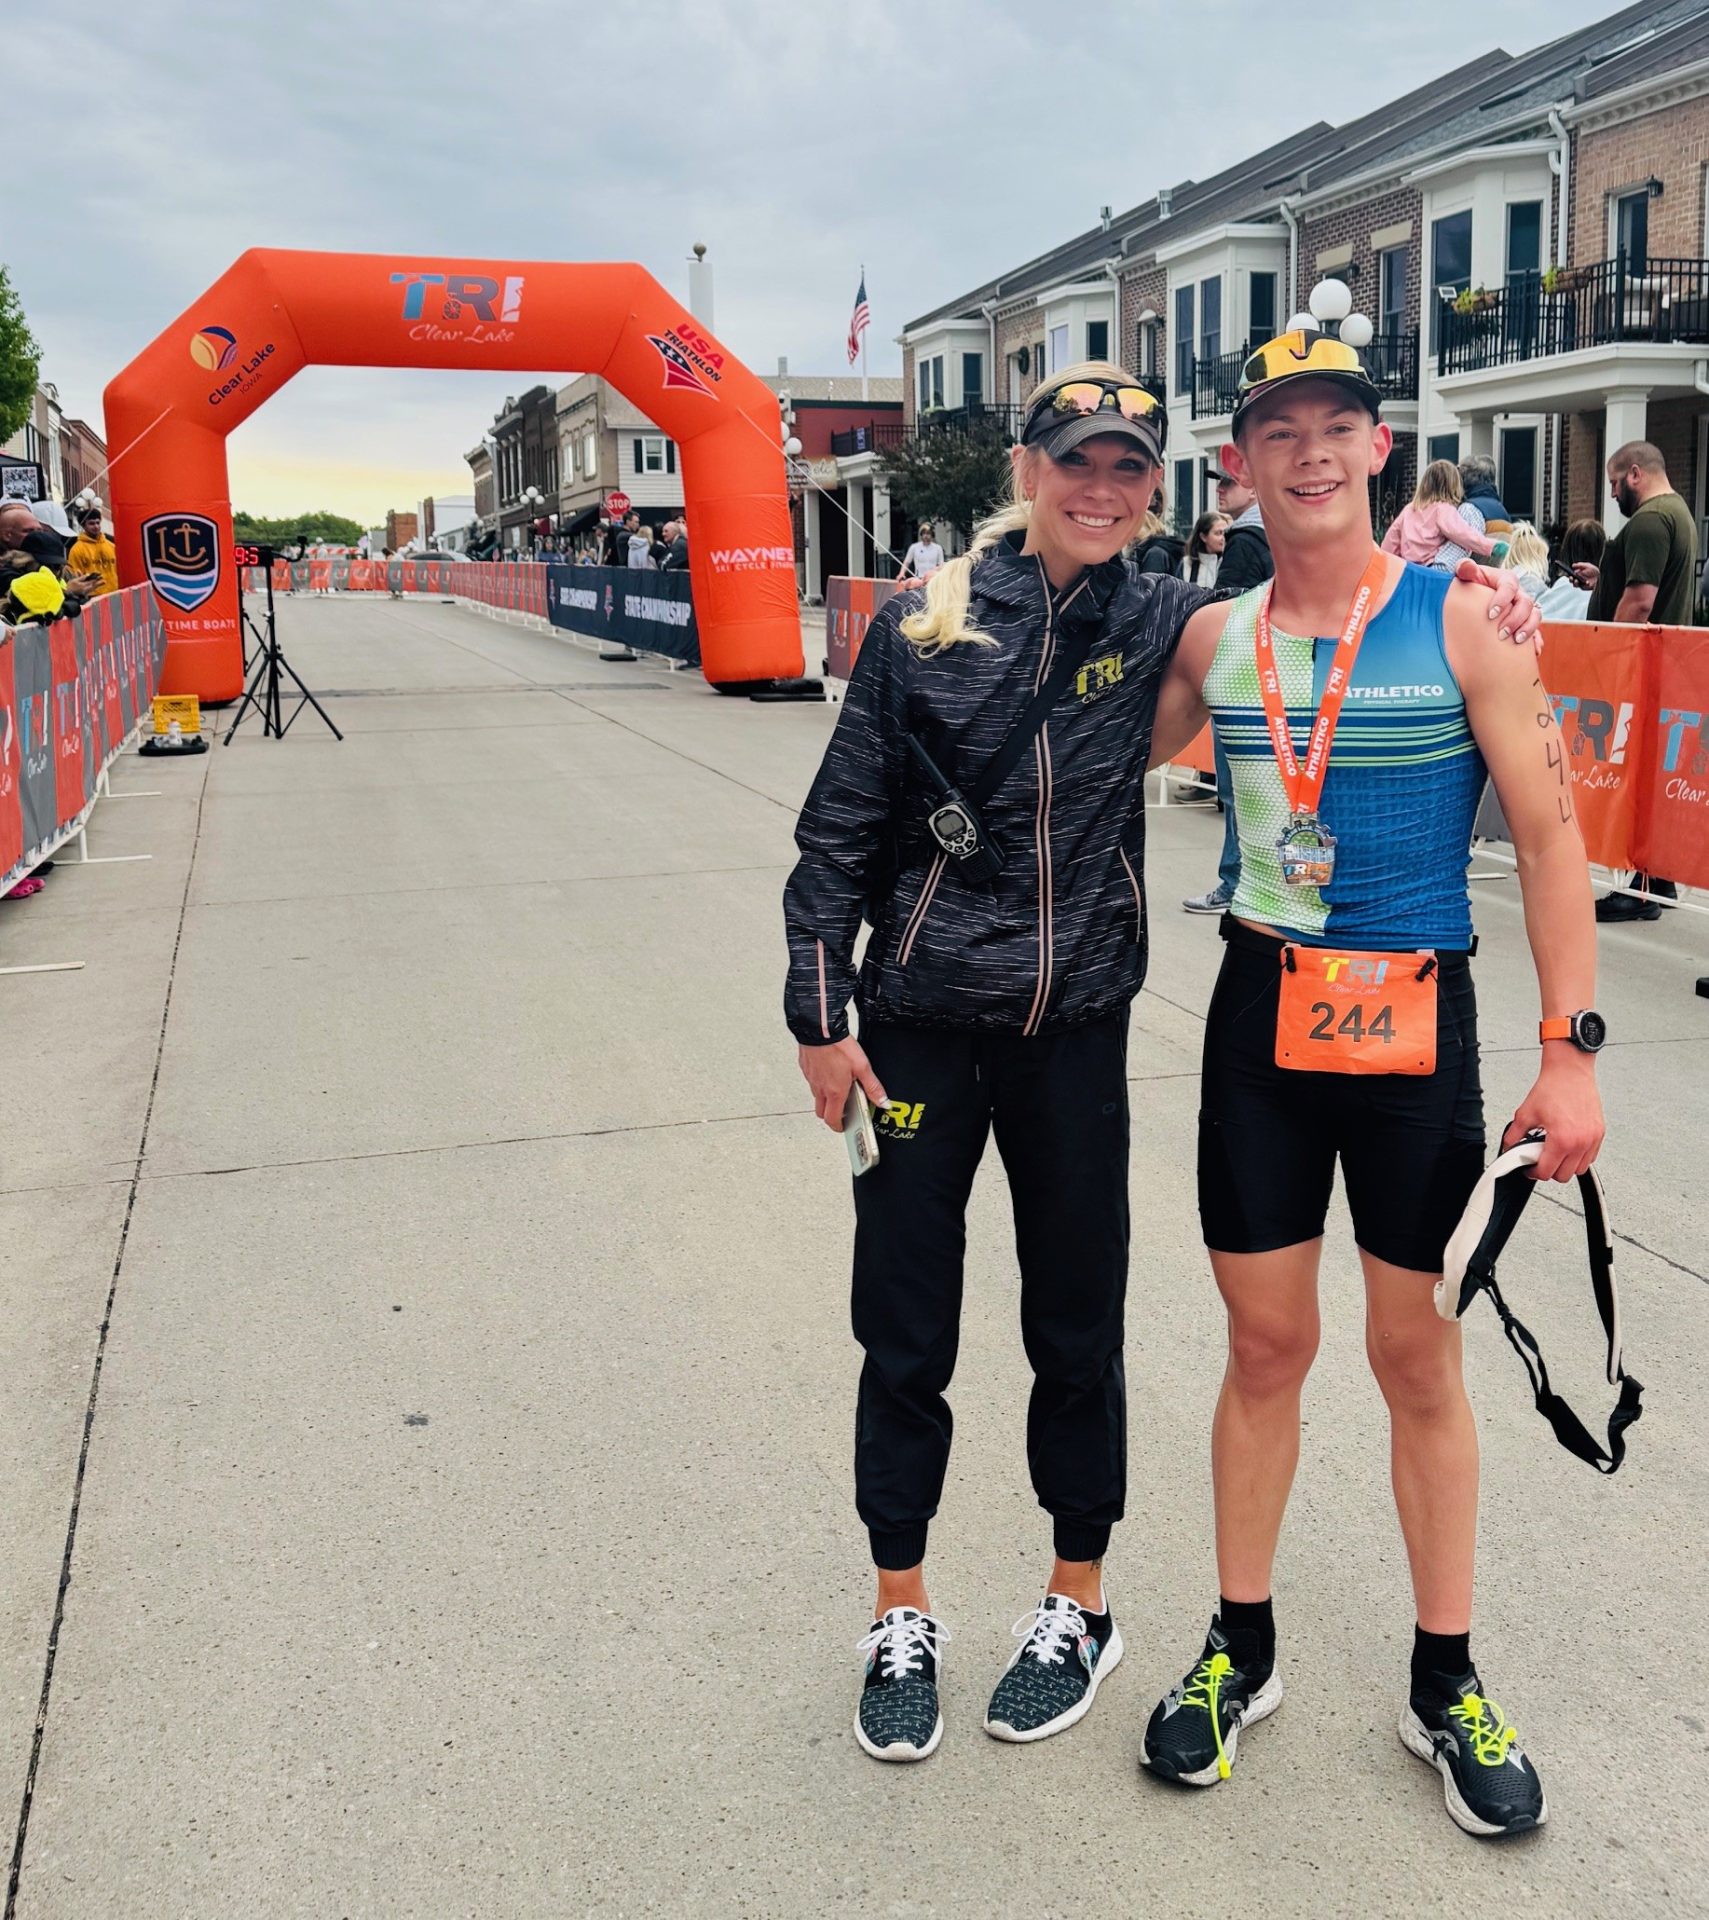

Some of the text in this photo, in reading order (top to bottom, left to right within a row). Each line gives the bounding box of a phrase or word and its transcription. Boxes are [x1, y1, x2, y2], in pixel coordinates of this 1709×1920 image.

[389, 272, 525, 322] TRI
[408, 323, 515, 344] Clear Lake
[676, 323, 724, 370] USA
[664, 328, 722, 382] TRIATHLON
[208, 343, 275, 405] Clear Lake
[240, 372, 263, 394] IOWA
[607, 498, 630, 510] STOP
[735, 560, 767, 572] CYCLE
[624, 594, 641, 619] STATE
[1343, 586, 1371, 646] ATHLETICO
[166, 620, 199, 631] TIME
[1077, 651, 1124, 695] TRI
[1326, 666, 1345, 695] TRI
[1344, 683, 1445, 699] ATHLETICO
[21, 690, 48, 755] TRI
[1274, 716, 1298, 777] ATHLETICO
[1305, 716, 1330, 781] ATHLETICO
[1583, 765, 1621, 789] Lake
[1665, 777, 1706, 803] Clear
[1322, 957, 1390, 985] TRI
[1309, 1001, 1396, 1044] 244
[885, 1099, 926, 1130] RI
[888, 1128, 916, 1139] Lake
